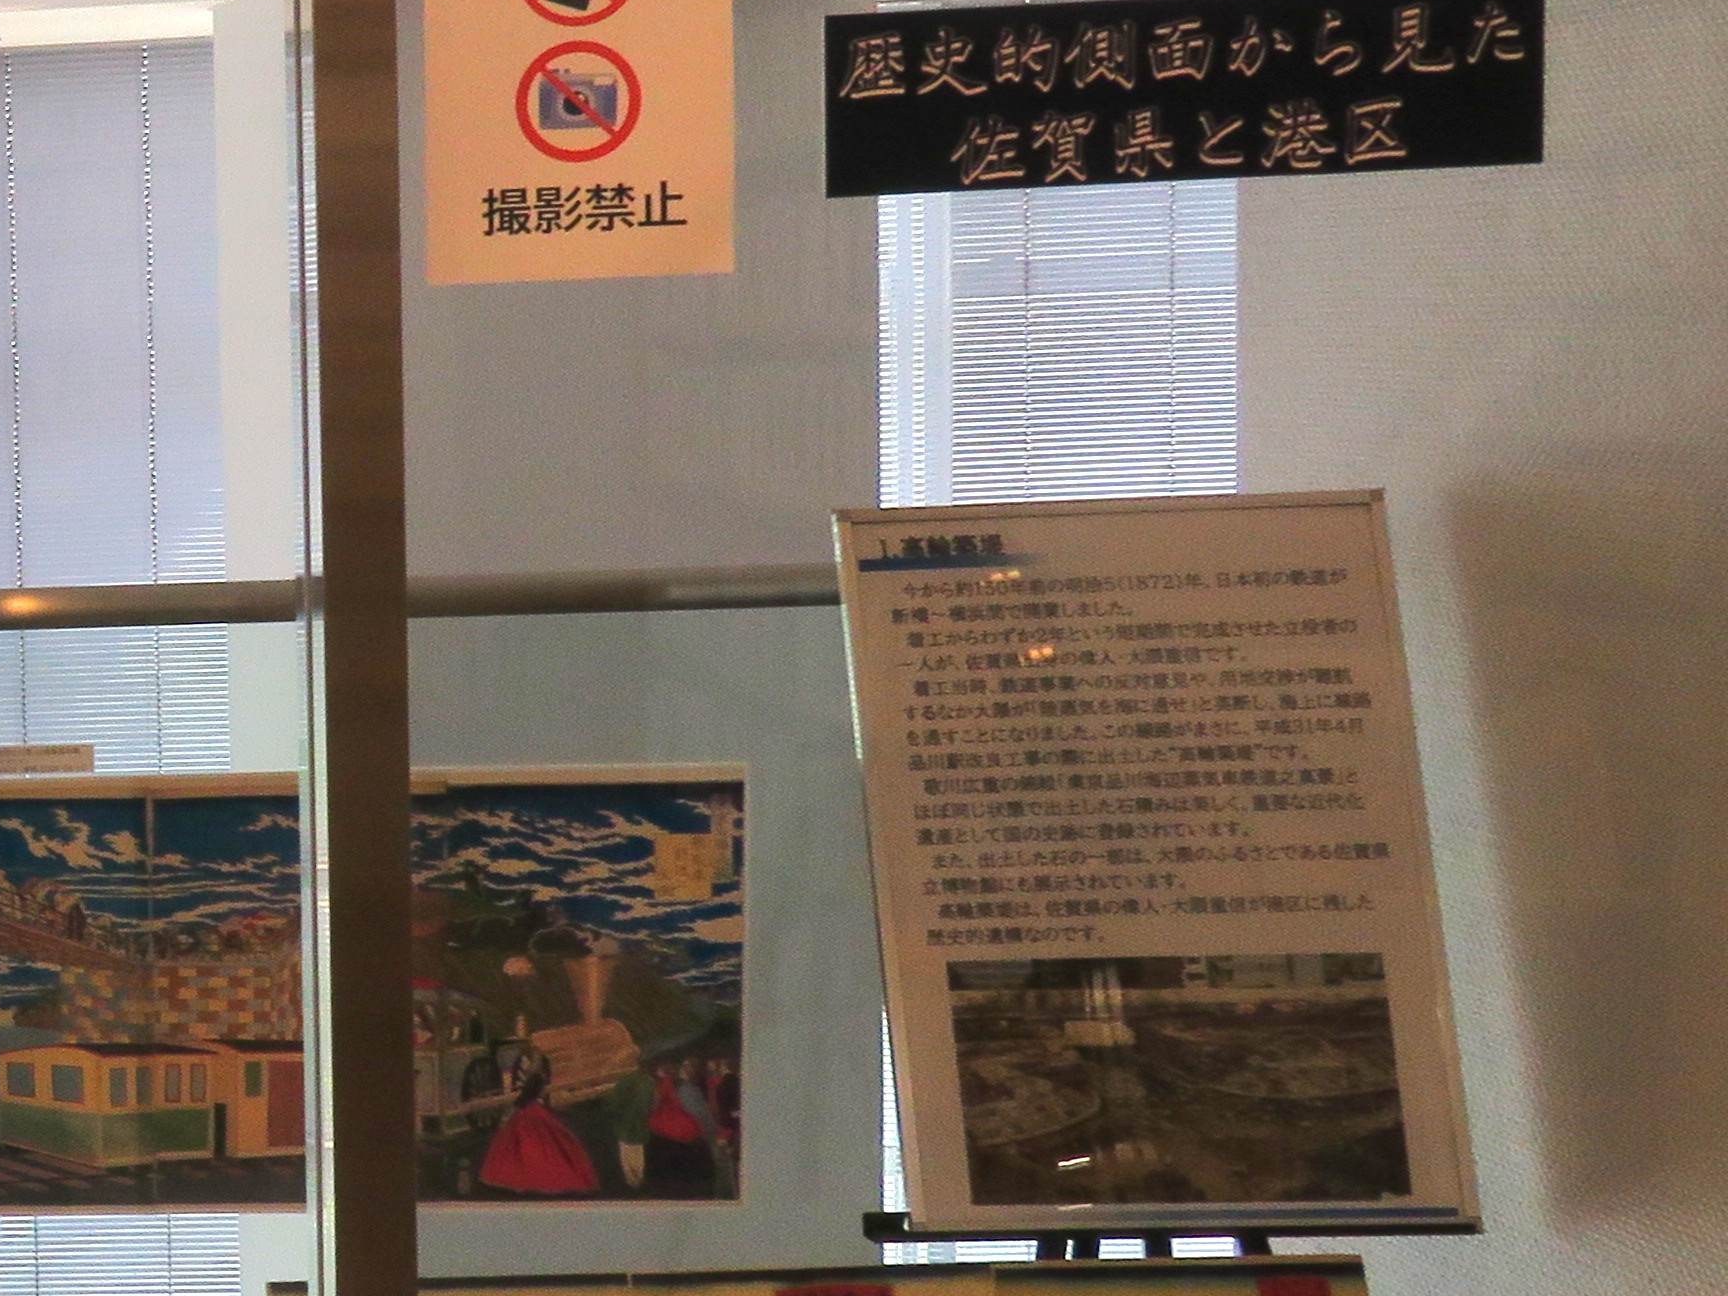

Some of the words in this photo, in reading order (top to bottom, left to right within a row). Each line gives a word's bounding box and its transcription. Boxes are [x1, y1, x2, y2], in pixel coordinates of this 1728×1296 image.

[839, 0, 1528, 102] 歴史的側面から見た
[953, 97, 1408, 187] 佐賀県と港区
[481, 182, 687, 238] 撮影禁止
